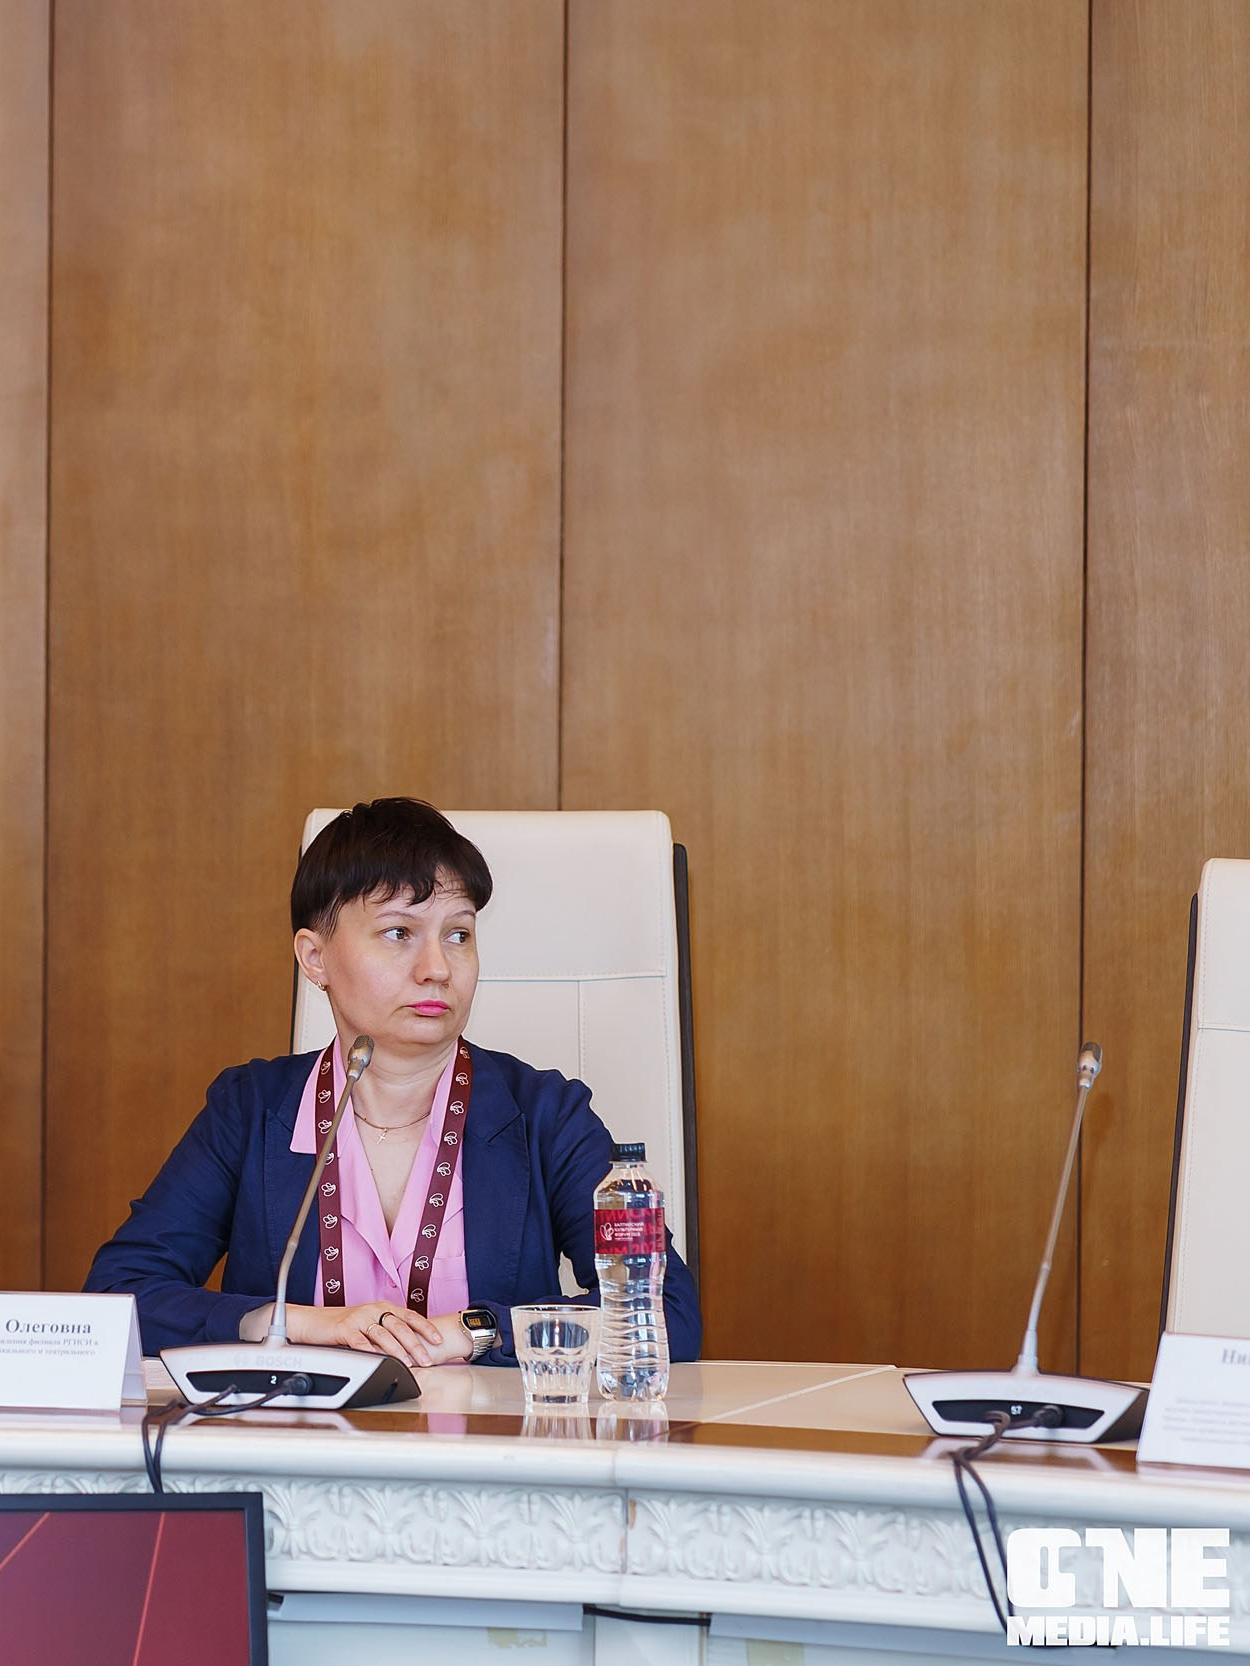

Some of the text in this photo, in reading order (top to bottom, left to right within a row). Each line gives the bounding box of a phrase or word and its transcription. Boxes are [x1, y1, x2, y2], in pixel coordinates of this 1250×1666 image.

[5, 1319, 92, 1334] Олеговна
[256, 1356, 302, 1367] BOSCH
[1221, 1348, 1250, 1365] Ни
[270, 1375, 277, 1384] 2
